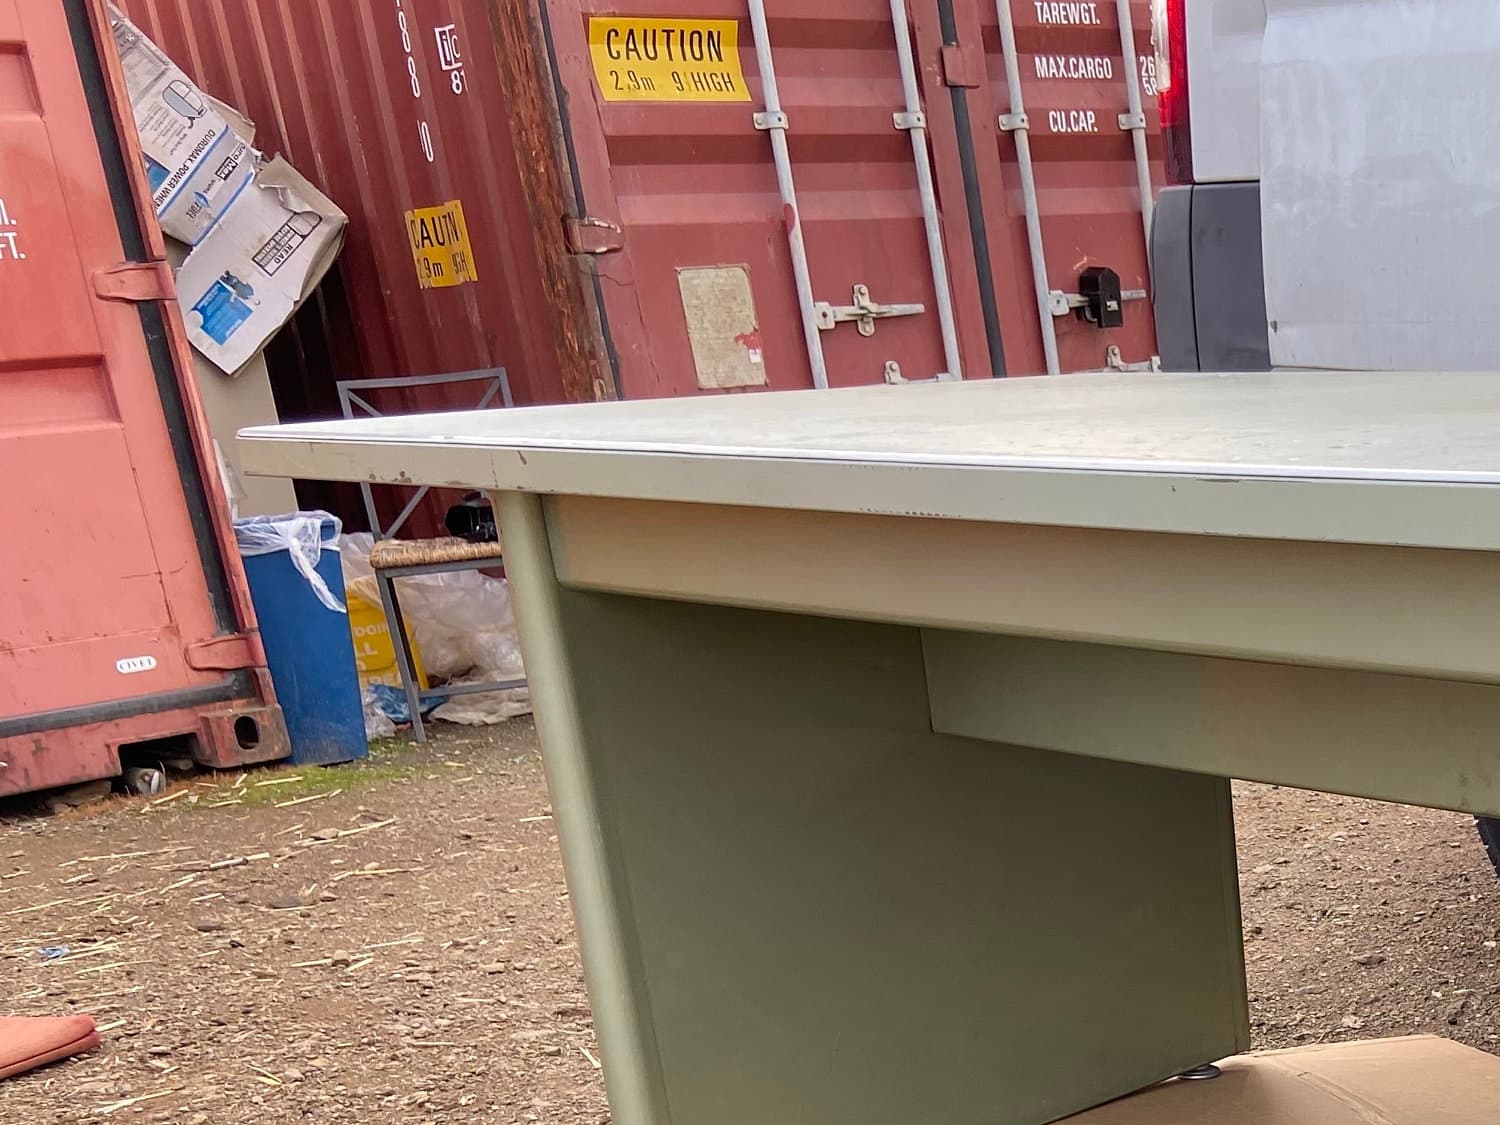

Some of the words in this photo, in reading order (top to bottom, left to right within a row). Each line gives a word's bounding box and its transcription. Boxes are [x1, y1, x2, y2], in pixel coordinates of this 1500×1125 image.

[607, 28, 724, 62] CAUTION
[1034, 56, 1113, 79] MAX.CARGO
[1049, 110, 1098, 133] CU.CAP.
